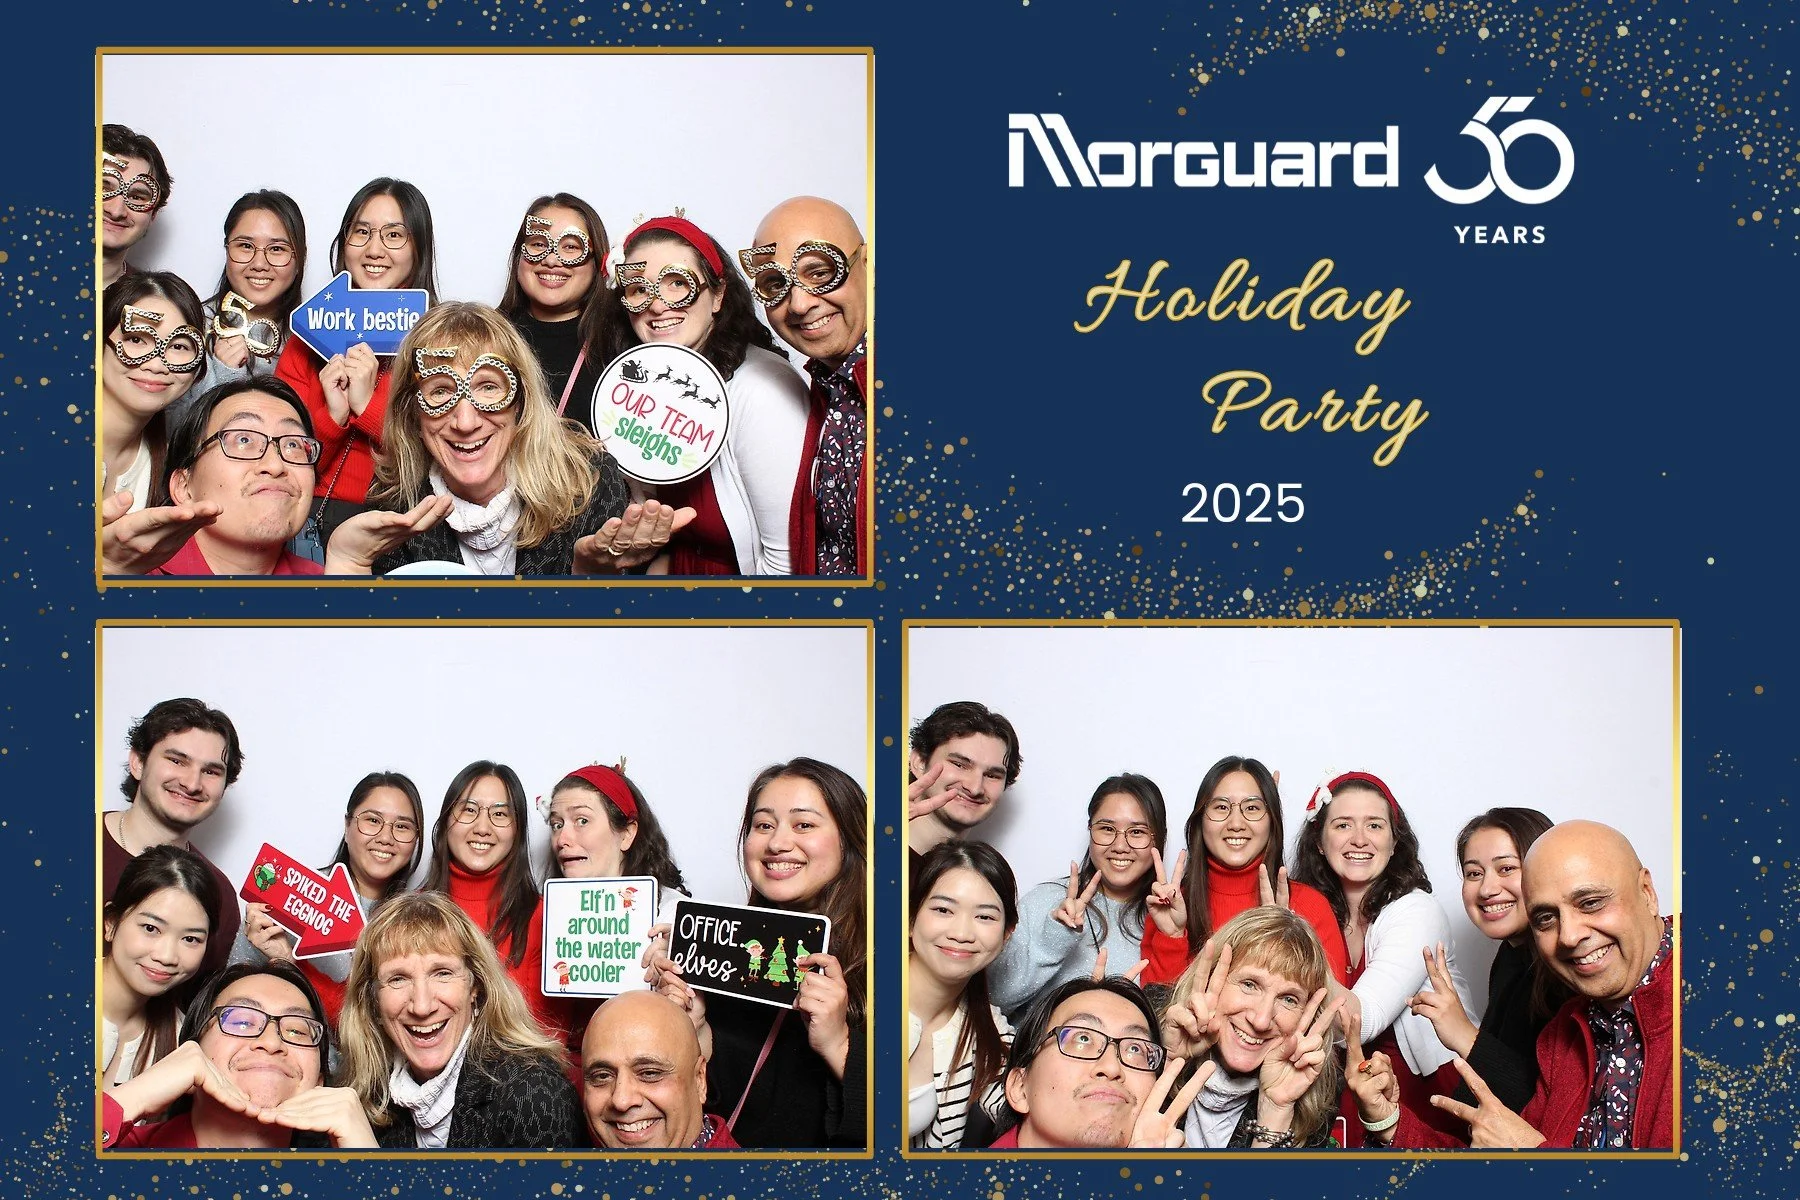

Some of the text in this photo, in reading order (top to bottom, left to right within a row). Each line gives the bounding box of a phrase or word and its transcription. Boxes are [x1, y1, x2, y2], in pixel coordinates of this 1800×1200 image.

[519, 214, 590, 266] 50
[615, 260, 700, 314] 50
[738, 238, 850, 308] 50
[114, 304, 205, 374] 50
[307, 307, 421, 331] Work bestie
[413, 345, 519, 418] 50
[611, 383, 715, 453] OUR TEAM
[614, 417, 682, 465] sleighs
[283, 867, 356, 923] SPIKED THE
[283, 893, 334, 935] EGGNOG
[580, 889, 616, 913] Elf'n
[568, 912, 630, 935] around
[680, 914, 742, 947] OFFICE
[556, 937, 642, 959] the water
[674, 943, 737, 982] elves
[569, 961, 625, 983] cooler
